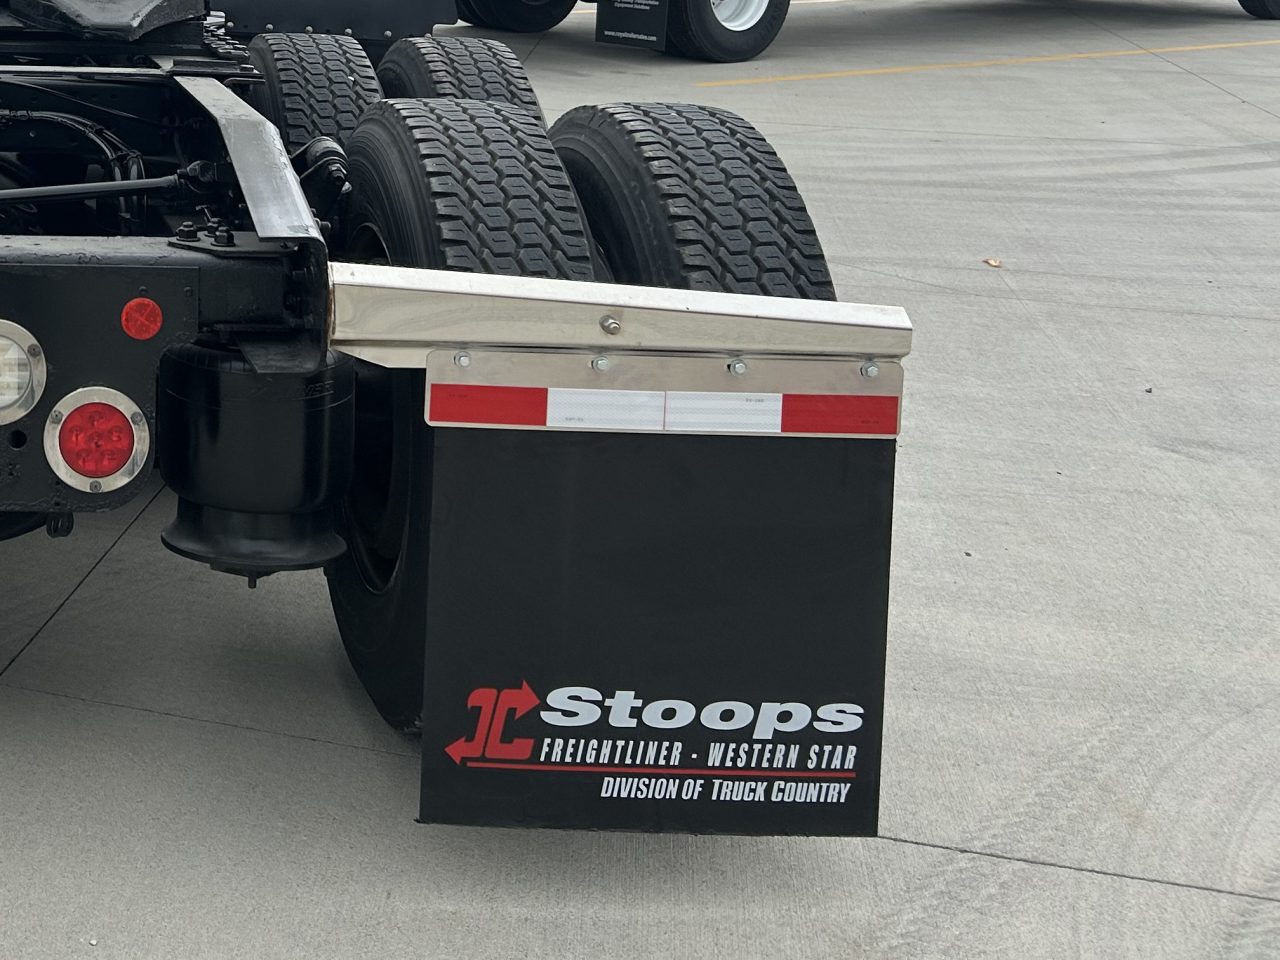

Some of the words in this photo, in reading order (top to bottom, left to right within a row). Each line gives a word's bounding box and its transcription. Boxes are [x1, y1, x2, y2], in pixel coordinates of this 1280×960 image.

[539, 686, 865, 740] Stoops
[539, 737, 683, 767] FREIGHTLINER
[707, 742, 800, 769] WESTERN
[806, 744, 857, 769] STAR
[600, 776, 679, 800] DIVISION
[681, 778, 705, 801] OF
[711, 779, 768, 802] TRUCK
[770, 781, 851, 803] COUNTRY
